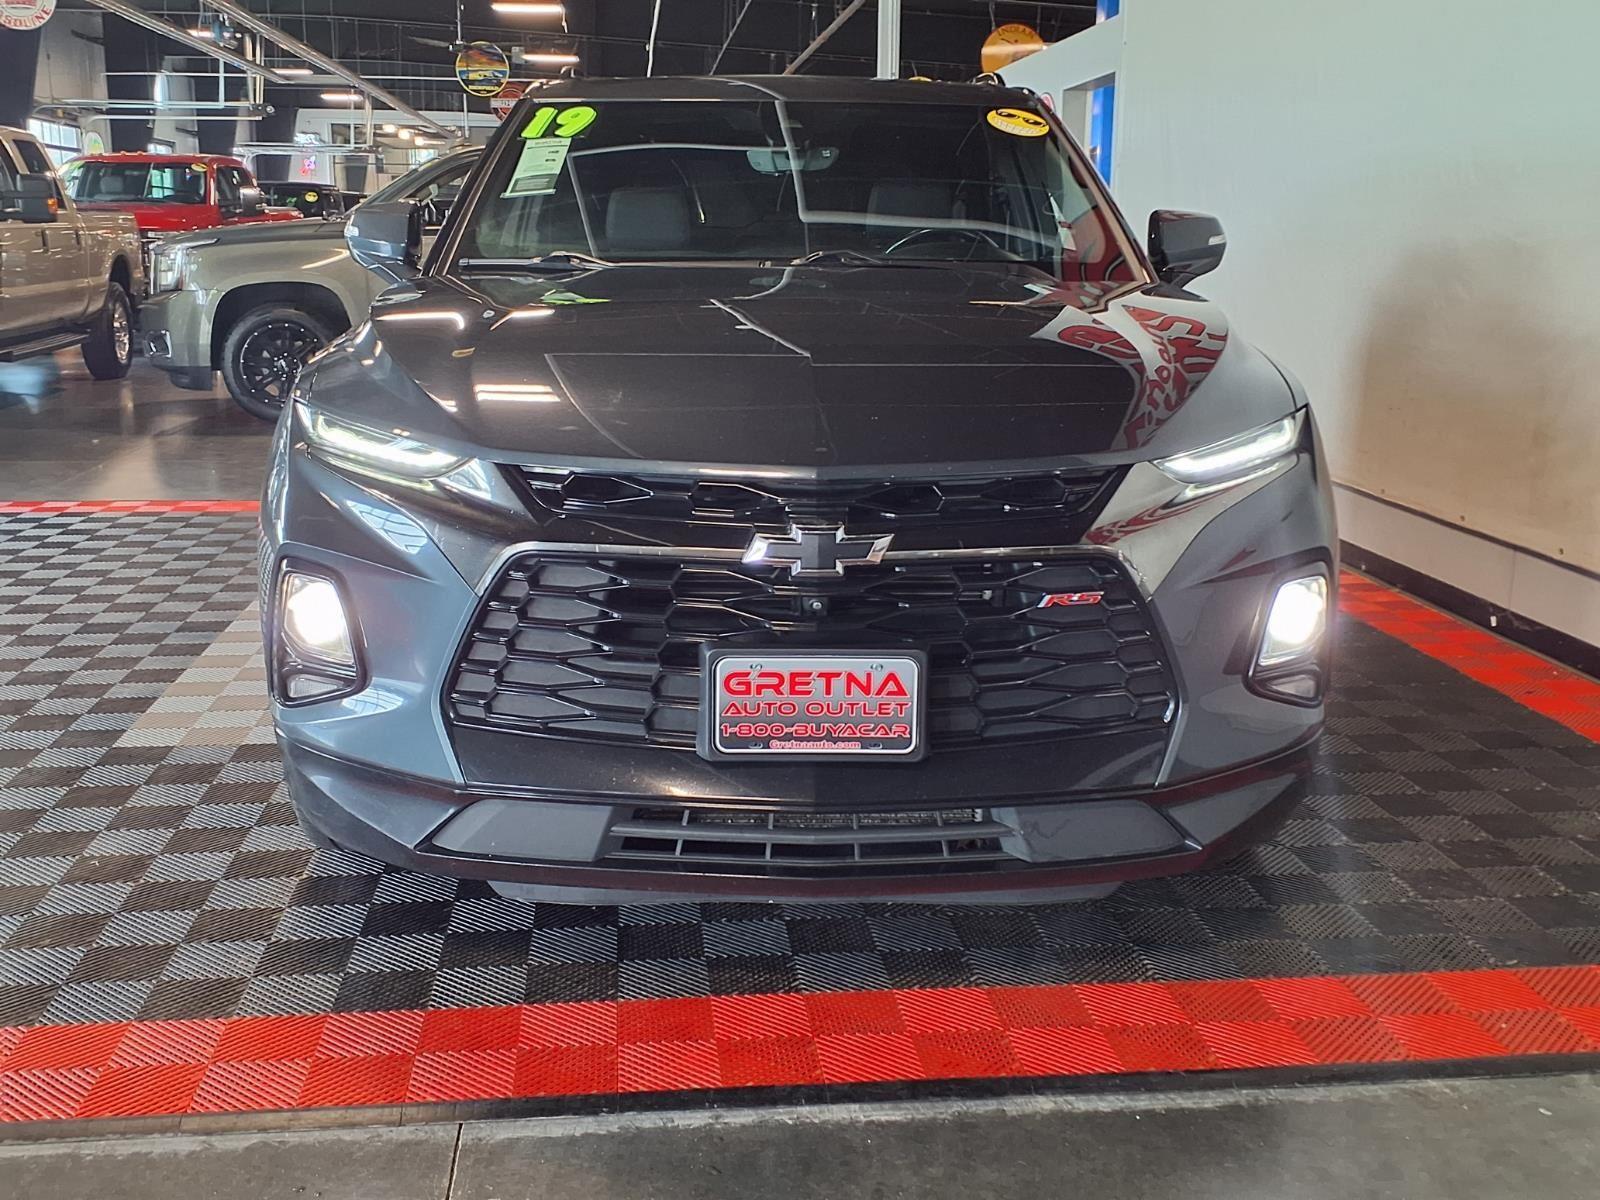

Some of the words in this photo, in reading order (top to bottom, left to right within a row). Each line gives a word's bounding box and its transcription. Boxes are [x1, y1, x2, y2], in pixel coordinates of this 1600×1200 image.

[521, 106, 597, 138] 19
[1037, 591, 1104, 608] RS
[723, 671, 910, 698] GRETNA
[721, 701, 798, 717] AUTO
[804, 701, 912, 717] OUTLET
[720, 723, 911, 738] 1-800-BUYACAR
